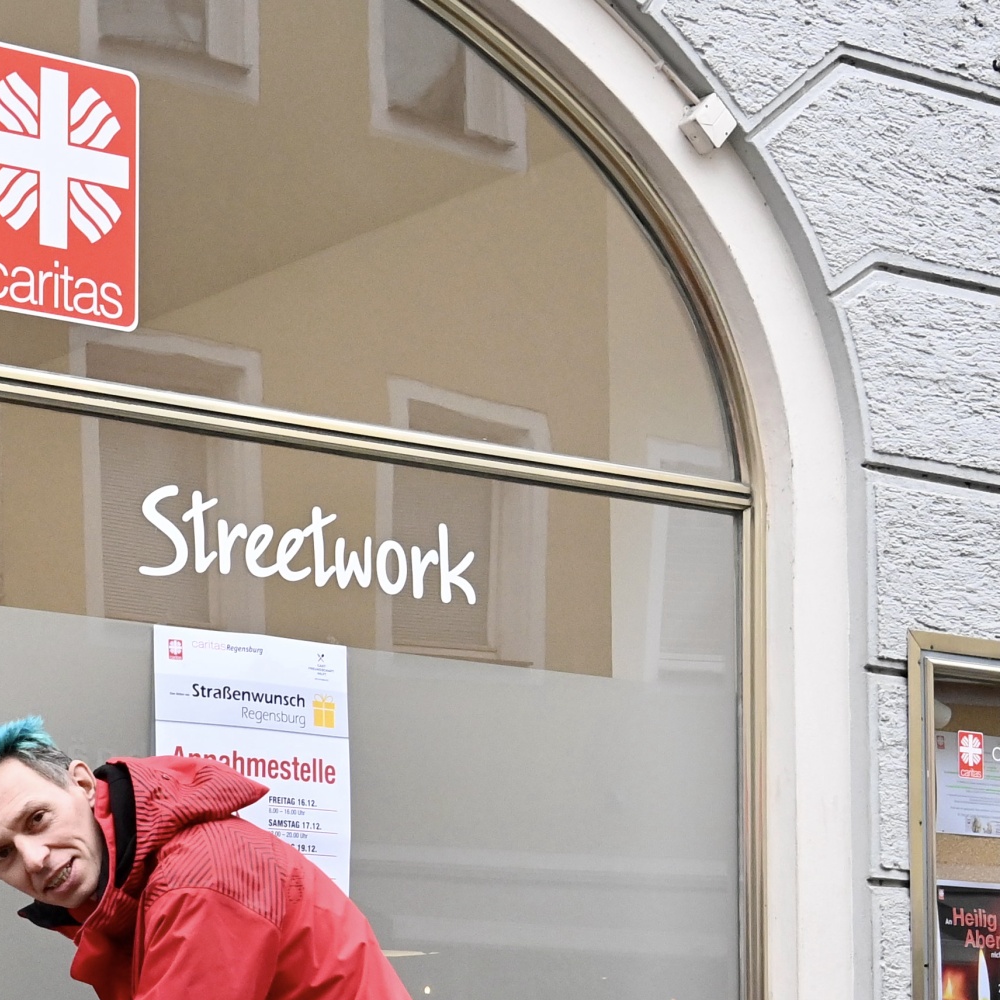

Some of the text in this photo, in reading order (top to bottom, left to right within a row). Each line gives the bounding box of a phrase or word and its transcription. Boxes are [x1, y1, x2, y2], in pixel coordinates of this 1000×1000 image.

[138, 484, 476, 605] Streetwork
[192, 683, 305, 708] Straßenwunsch
[241, 707, 306, 728] Regensburg
[174, 746, 336, 784] hmestelle
[268, 796, 295, 805] FREITAG
[268, 819, 322, 830] SAMSTAG 17.12.
[953, 907, 997, 932] Heilig
